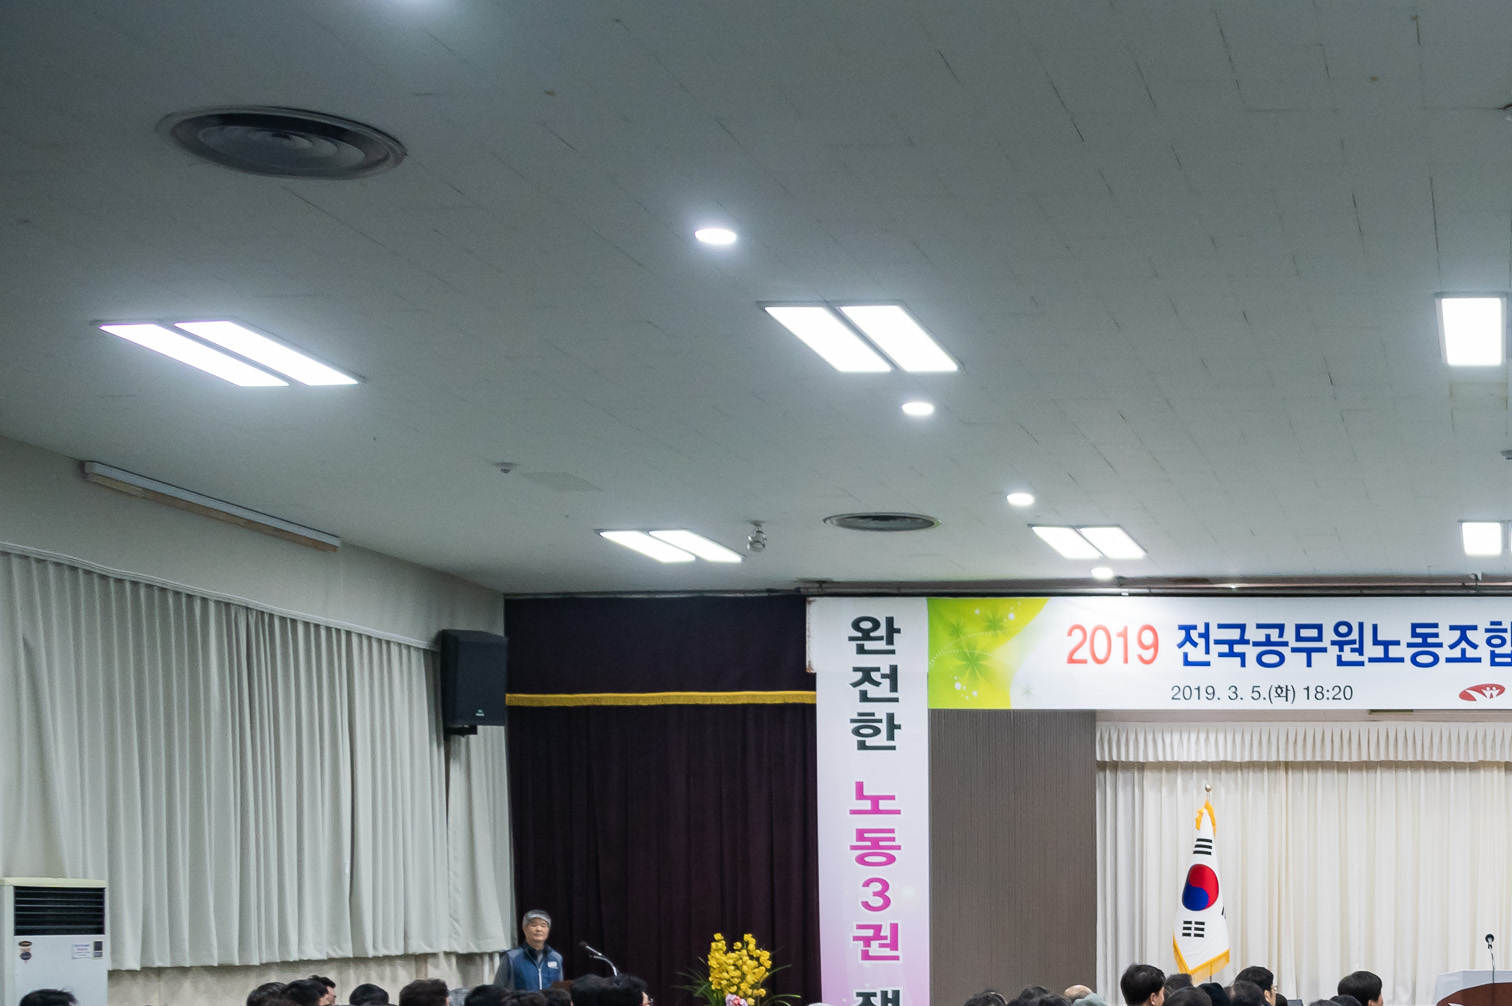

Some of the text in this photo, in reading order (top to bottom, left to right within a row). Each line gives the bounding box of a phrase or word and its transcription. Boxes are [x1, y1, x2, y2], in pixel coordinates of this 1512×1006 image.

[848, 615, 901, 751] 완전한
[1066, 624, 1159, 665] 2019
[1171, 684, 1354, 704] 2019. 3. 5.(화) 18:20
[849, 780, 901, 962] 노동3권
